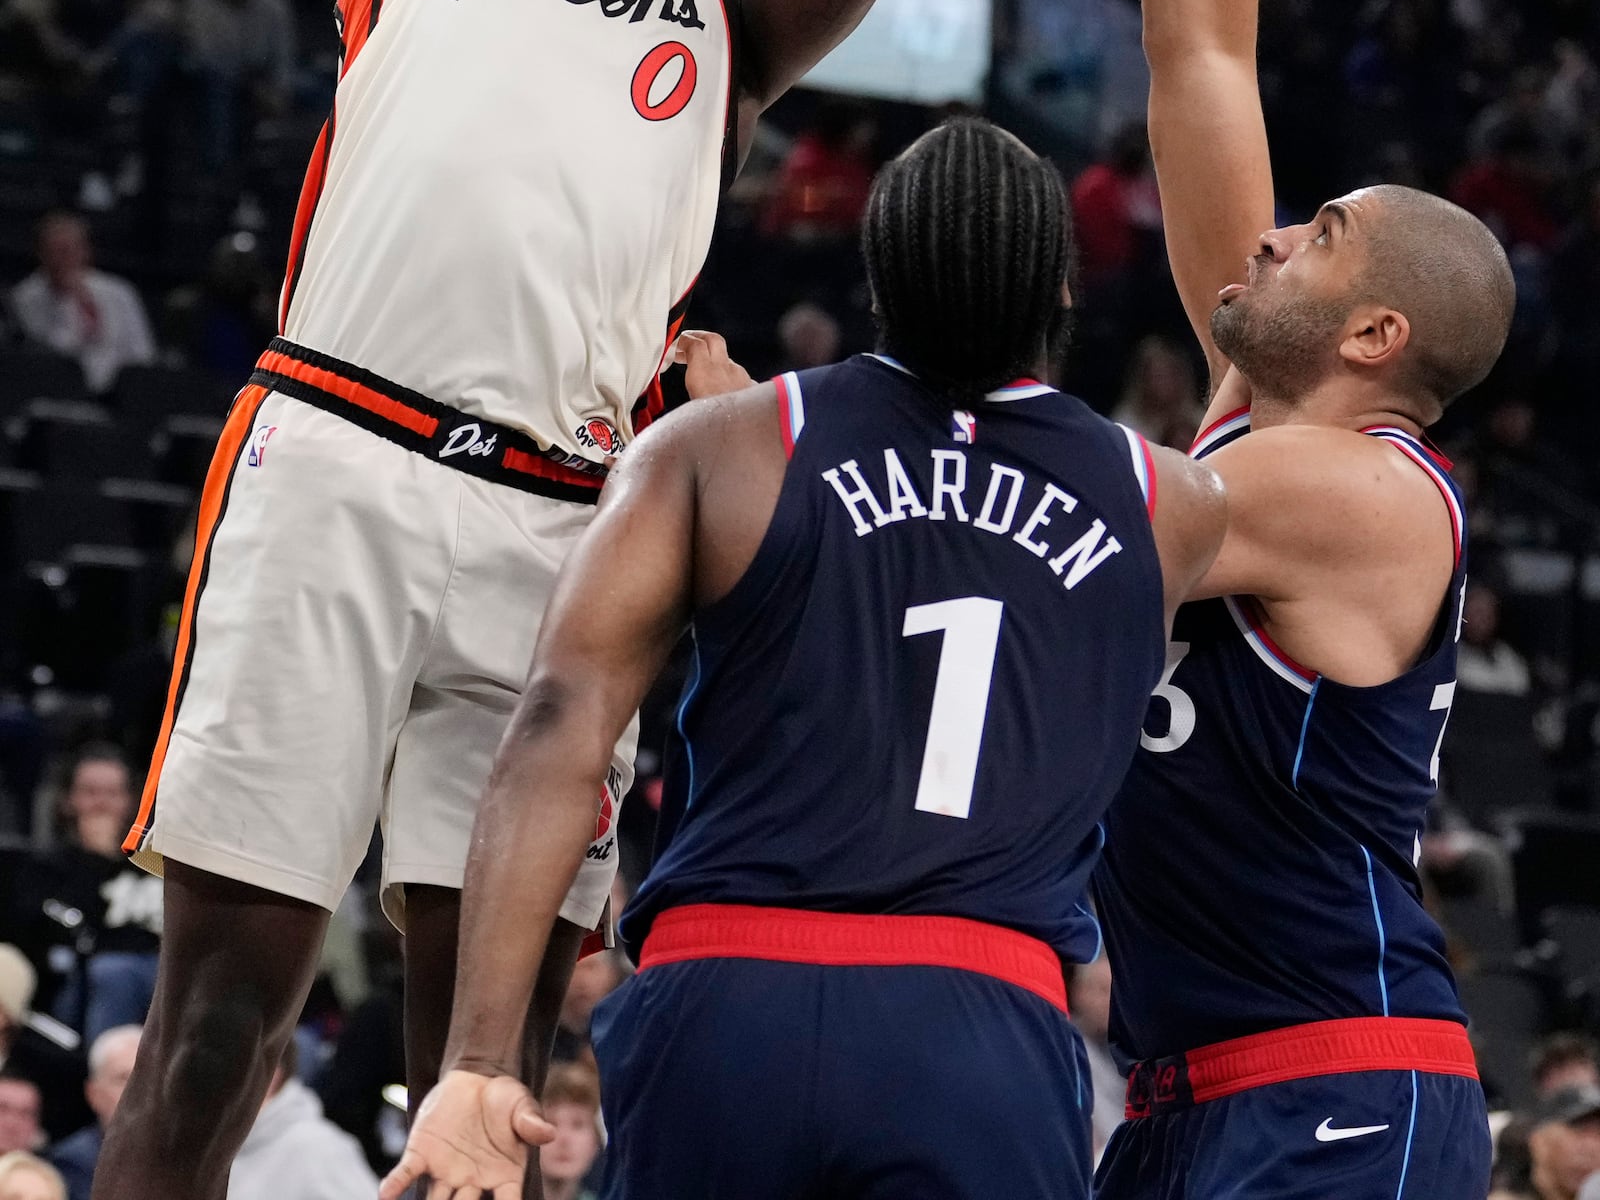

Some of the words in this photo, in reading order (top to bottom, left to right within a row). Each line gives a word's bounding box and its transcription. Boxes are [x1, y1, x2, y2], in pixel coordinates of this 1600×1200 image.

[630, 40, 697, 121] 0
[439, 423, 498, 458] Det
[821, 448, 1123, 590] HARDEN
[902, 596, 1004, 819] 1
